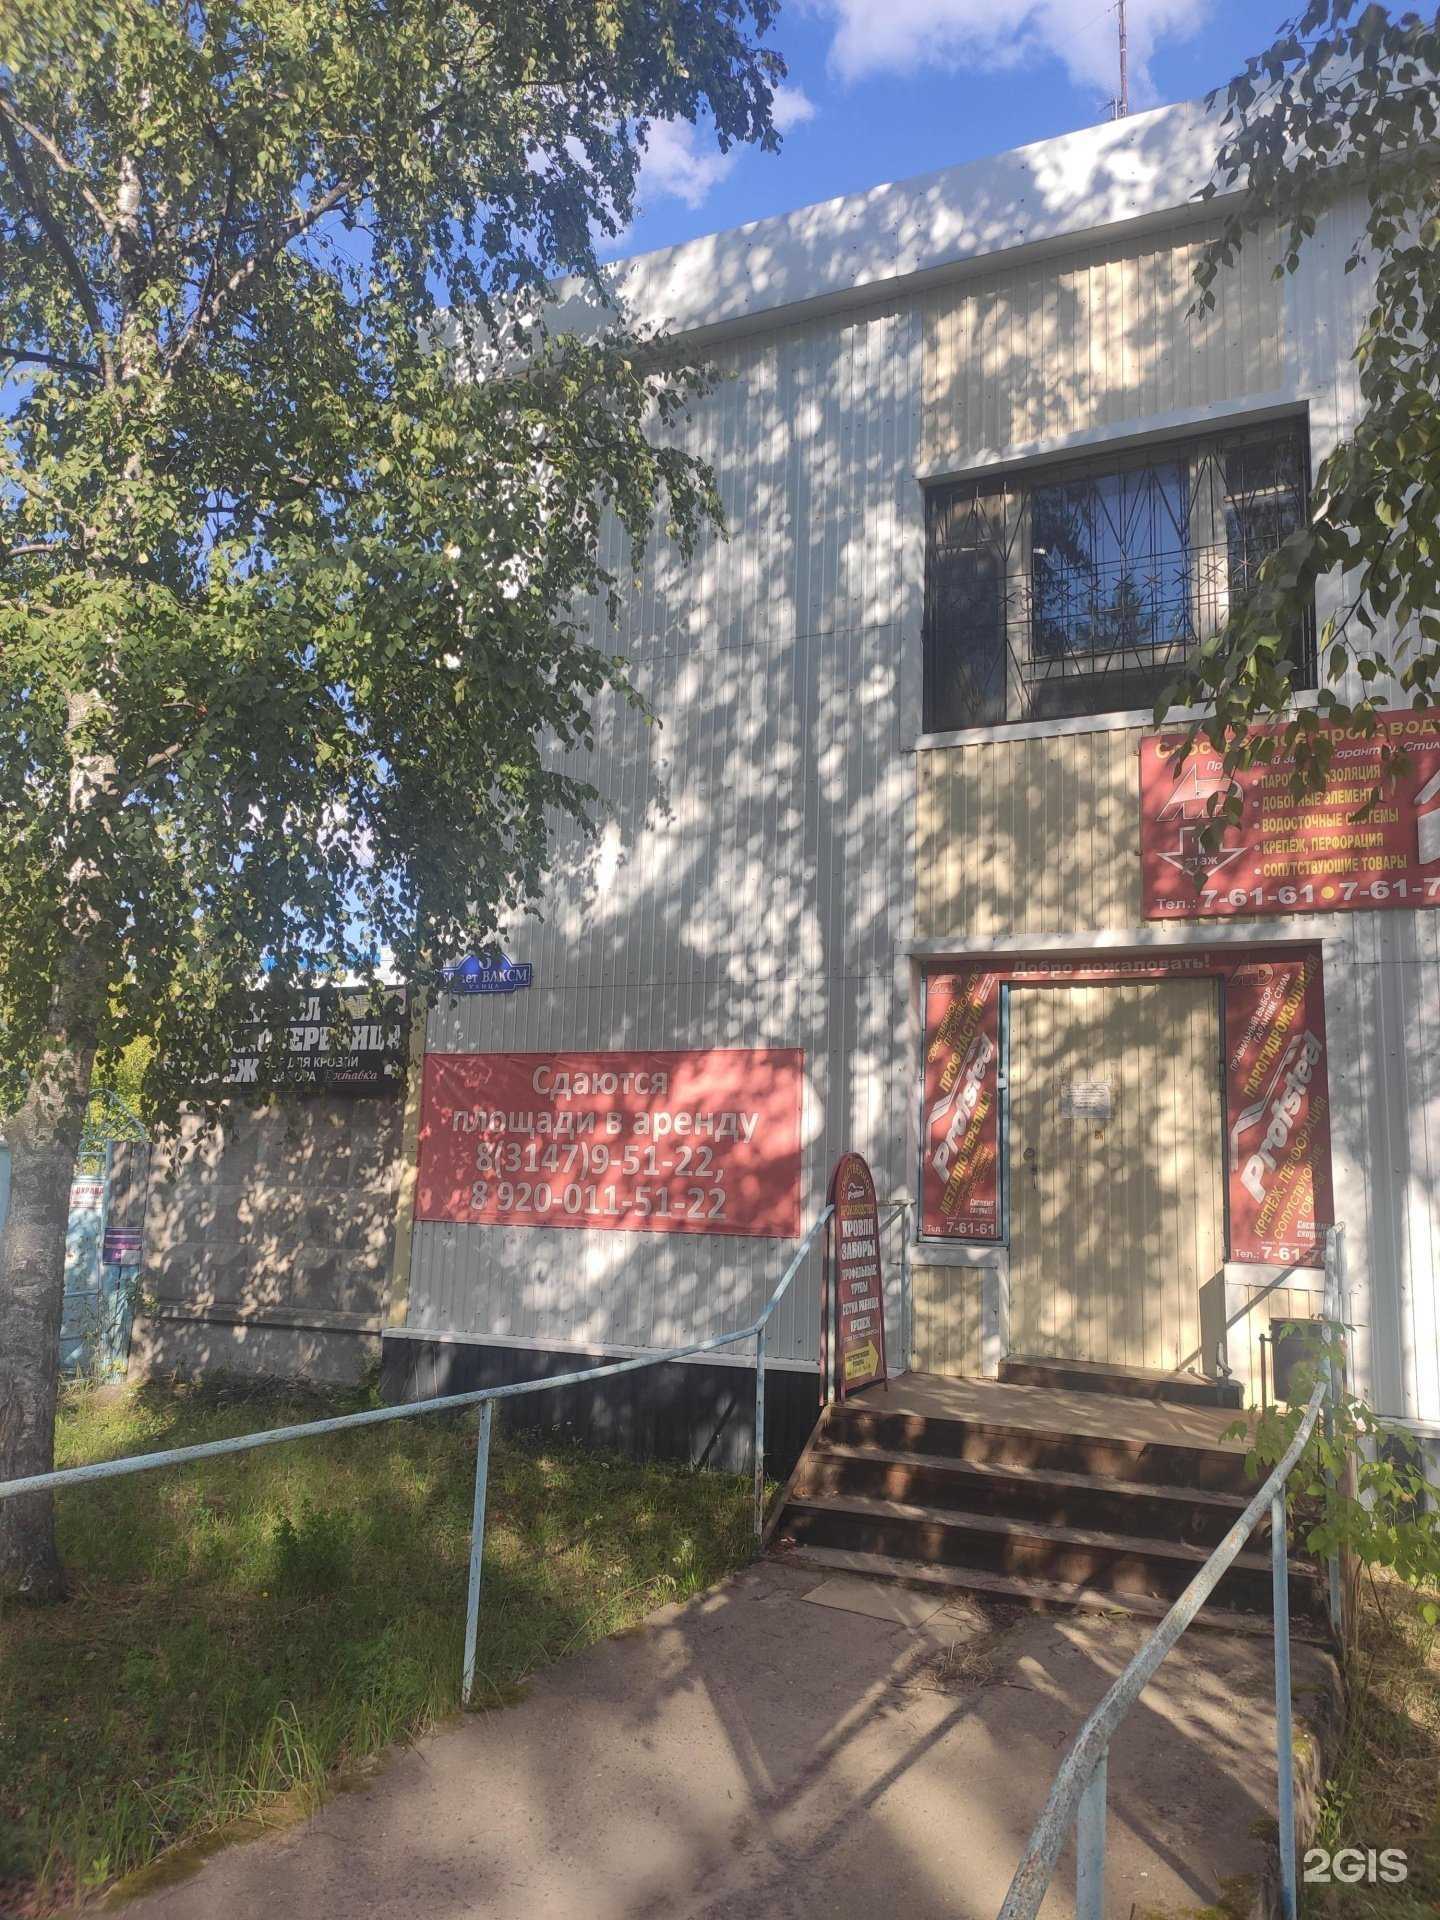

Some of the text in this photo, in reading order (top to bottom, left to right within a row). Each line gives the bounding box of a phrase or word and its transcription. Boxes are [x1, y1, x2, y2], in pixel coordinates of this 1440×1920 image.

[1262, 813, 1343, 834] ВОДОСТОЧНЫЕ
[1311, 832, 1384, 851] ПЕРФОРАЦИЯ
[1263, 854, 1408, 877] СОПУТСТВУЮЩИЕ ТОВАРЫ
[1156, 898, 1196, 911] Тел.:
[1200, 883, 1314, 909] 7-61-61
[482, 968, 527, 983] ВЛКСМ
[1012, 953, 1210, 977] Добро пожаловать!
[1243, 953, 1320, 1098] ПАРОГИДРОИЗОЛЯЦИЯ
[532, 1066, 668, 1101] Сдаются
[452, 1111, 758, 1142] площади в аренду
[475, 1143, 725, 1182] 8(3147)9-51-22,
[470, 1181, 728, 1219] 8 920-011-51-22
[946, 1222, 995, 1235] 7-61-61
[841, 1240, 876, 1261] ЗАБОРЫ
